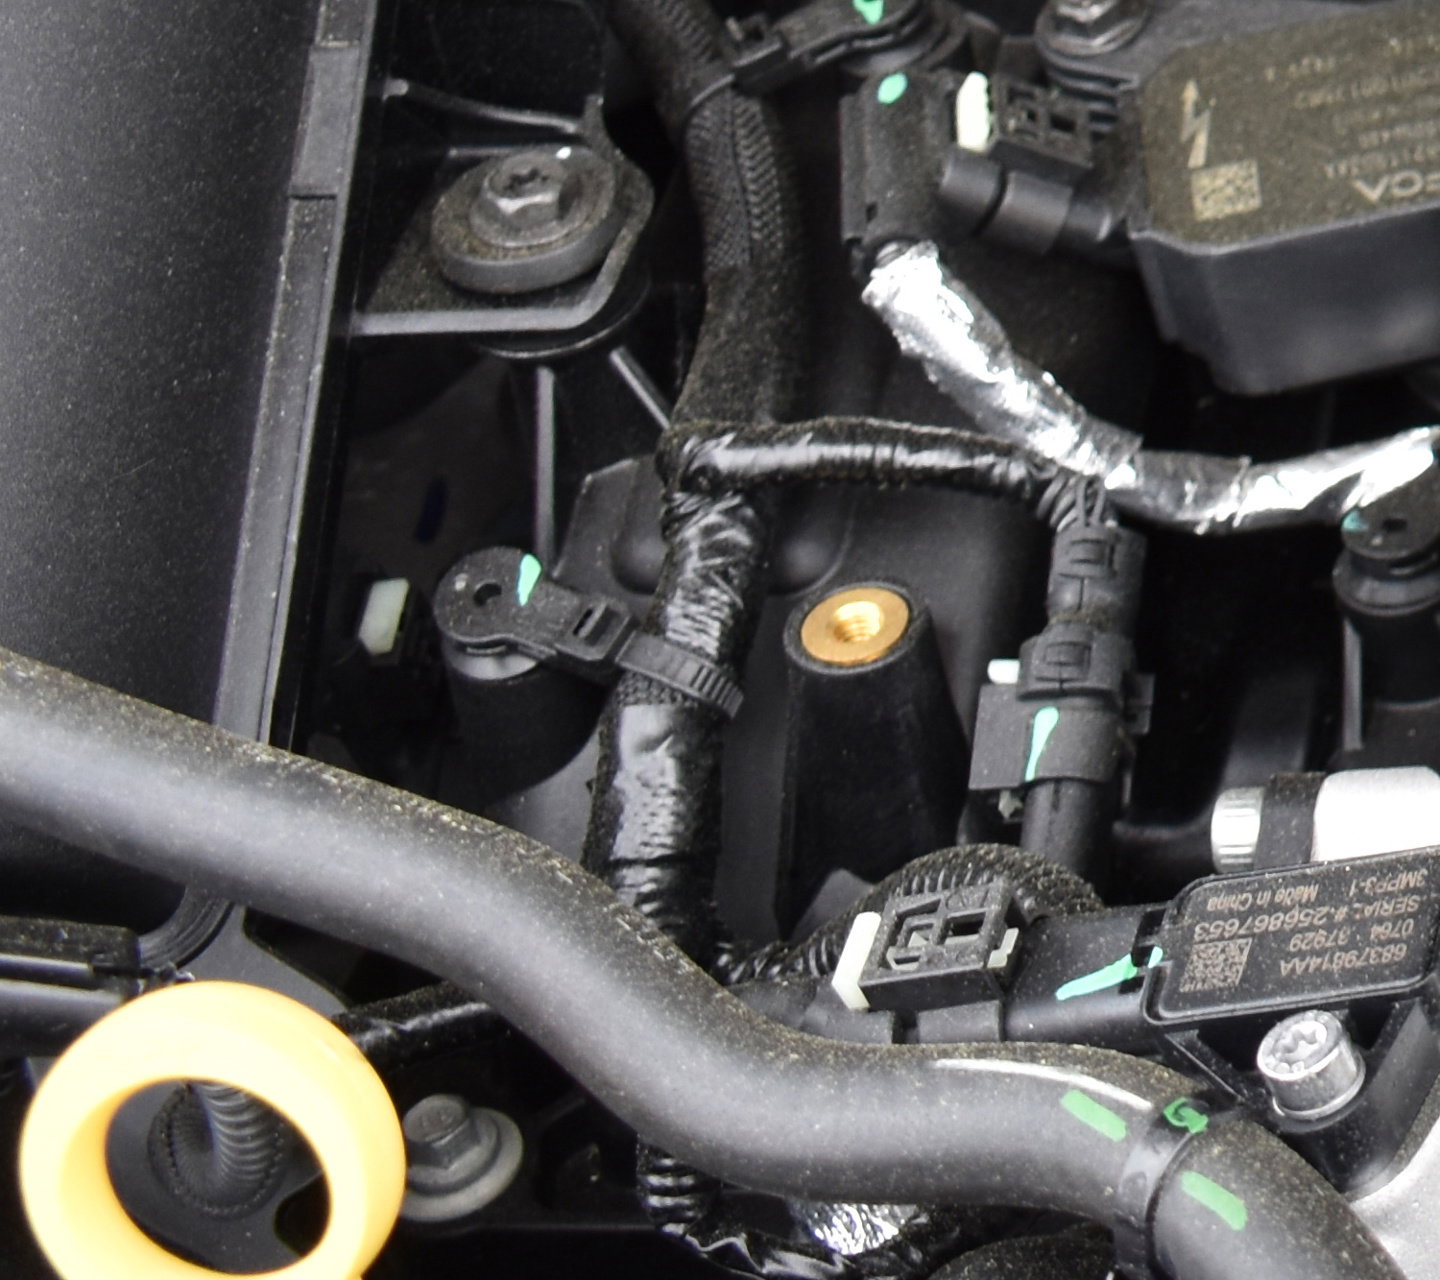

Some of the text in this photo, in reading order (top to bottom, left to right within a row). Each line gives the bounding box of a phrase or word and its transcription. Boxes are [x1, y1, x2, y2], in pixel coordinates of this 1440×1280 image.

[1256, 891, 1270, 905] in
[1275, 883, 1319, 904] Made
[1206, 896, 1252, 912] China
[1281, 942, 1408, 977] 68379814AA
